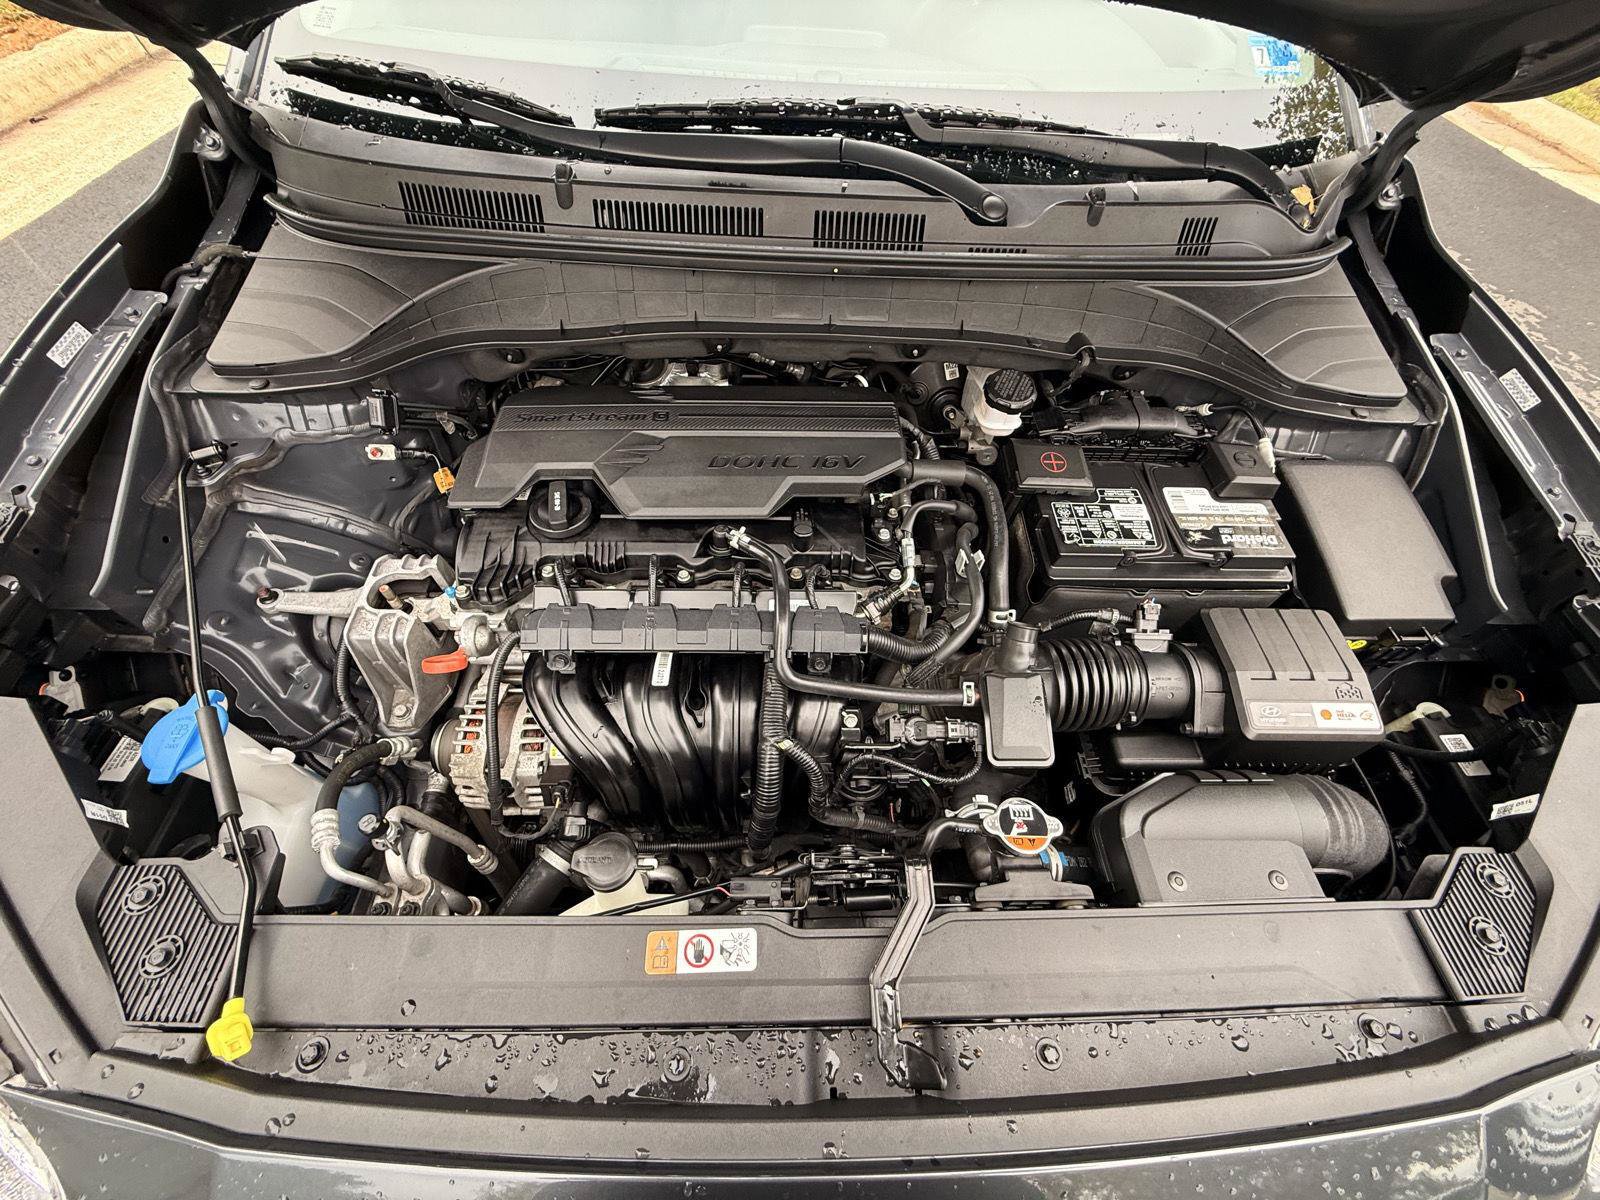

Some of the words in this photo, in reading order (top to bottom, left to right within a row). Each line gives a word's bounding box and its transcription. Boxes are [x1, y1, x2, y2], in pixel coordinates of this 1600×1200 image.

[514, 412, 649, 423] Smartstream
[707, 454, 804, 470] DOHC
[810, 453, 867, 470] 16V
[1220, 533, 1279, 546] DieHard
